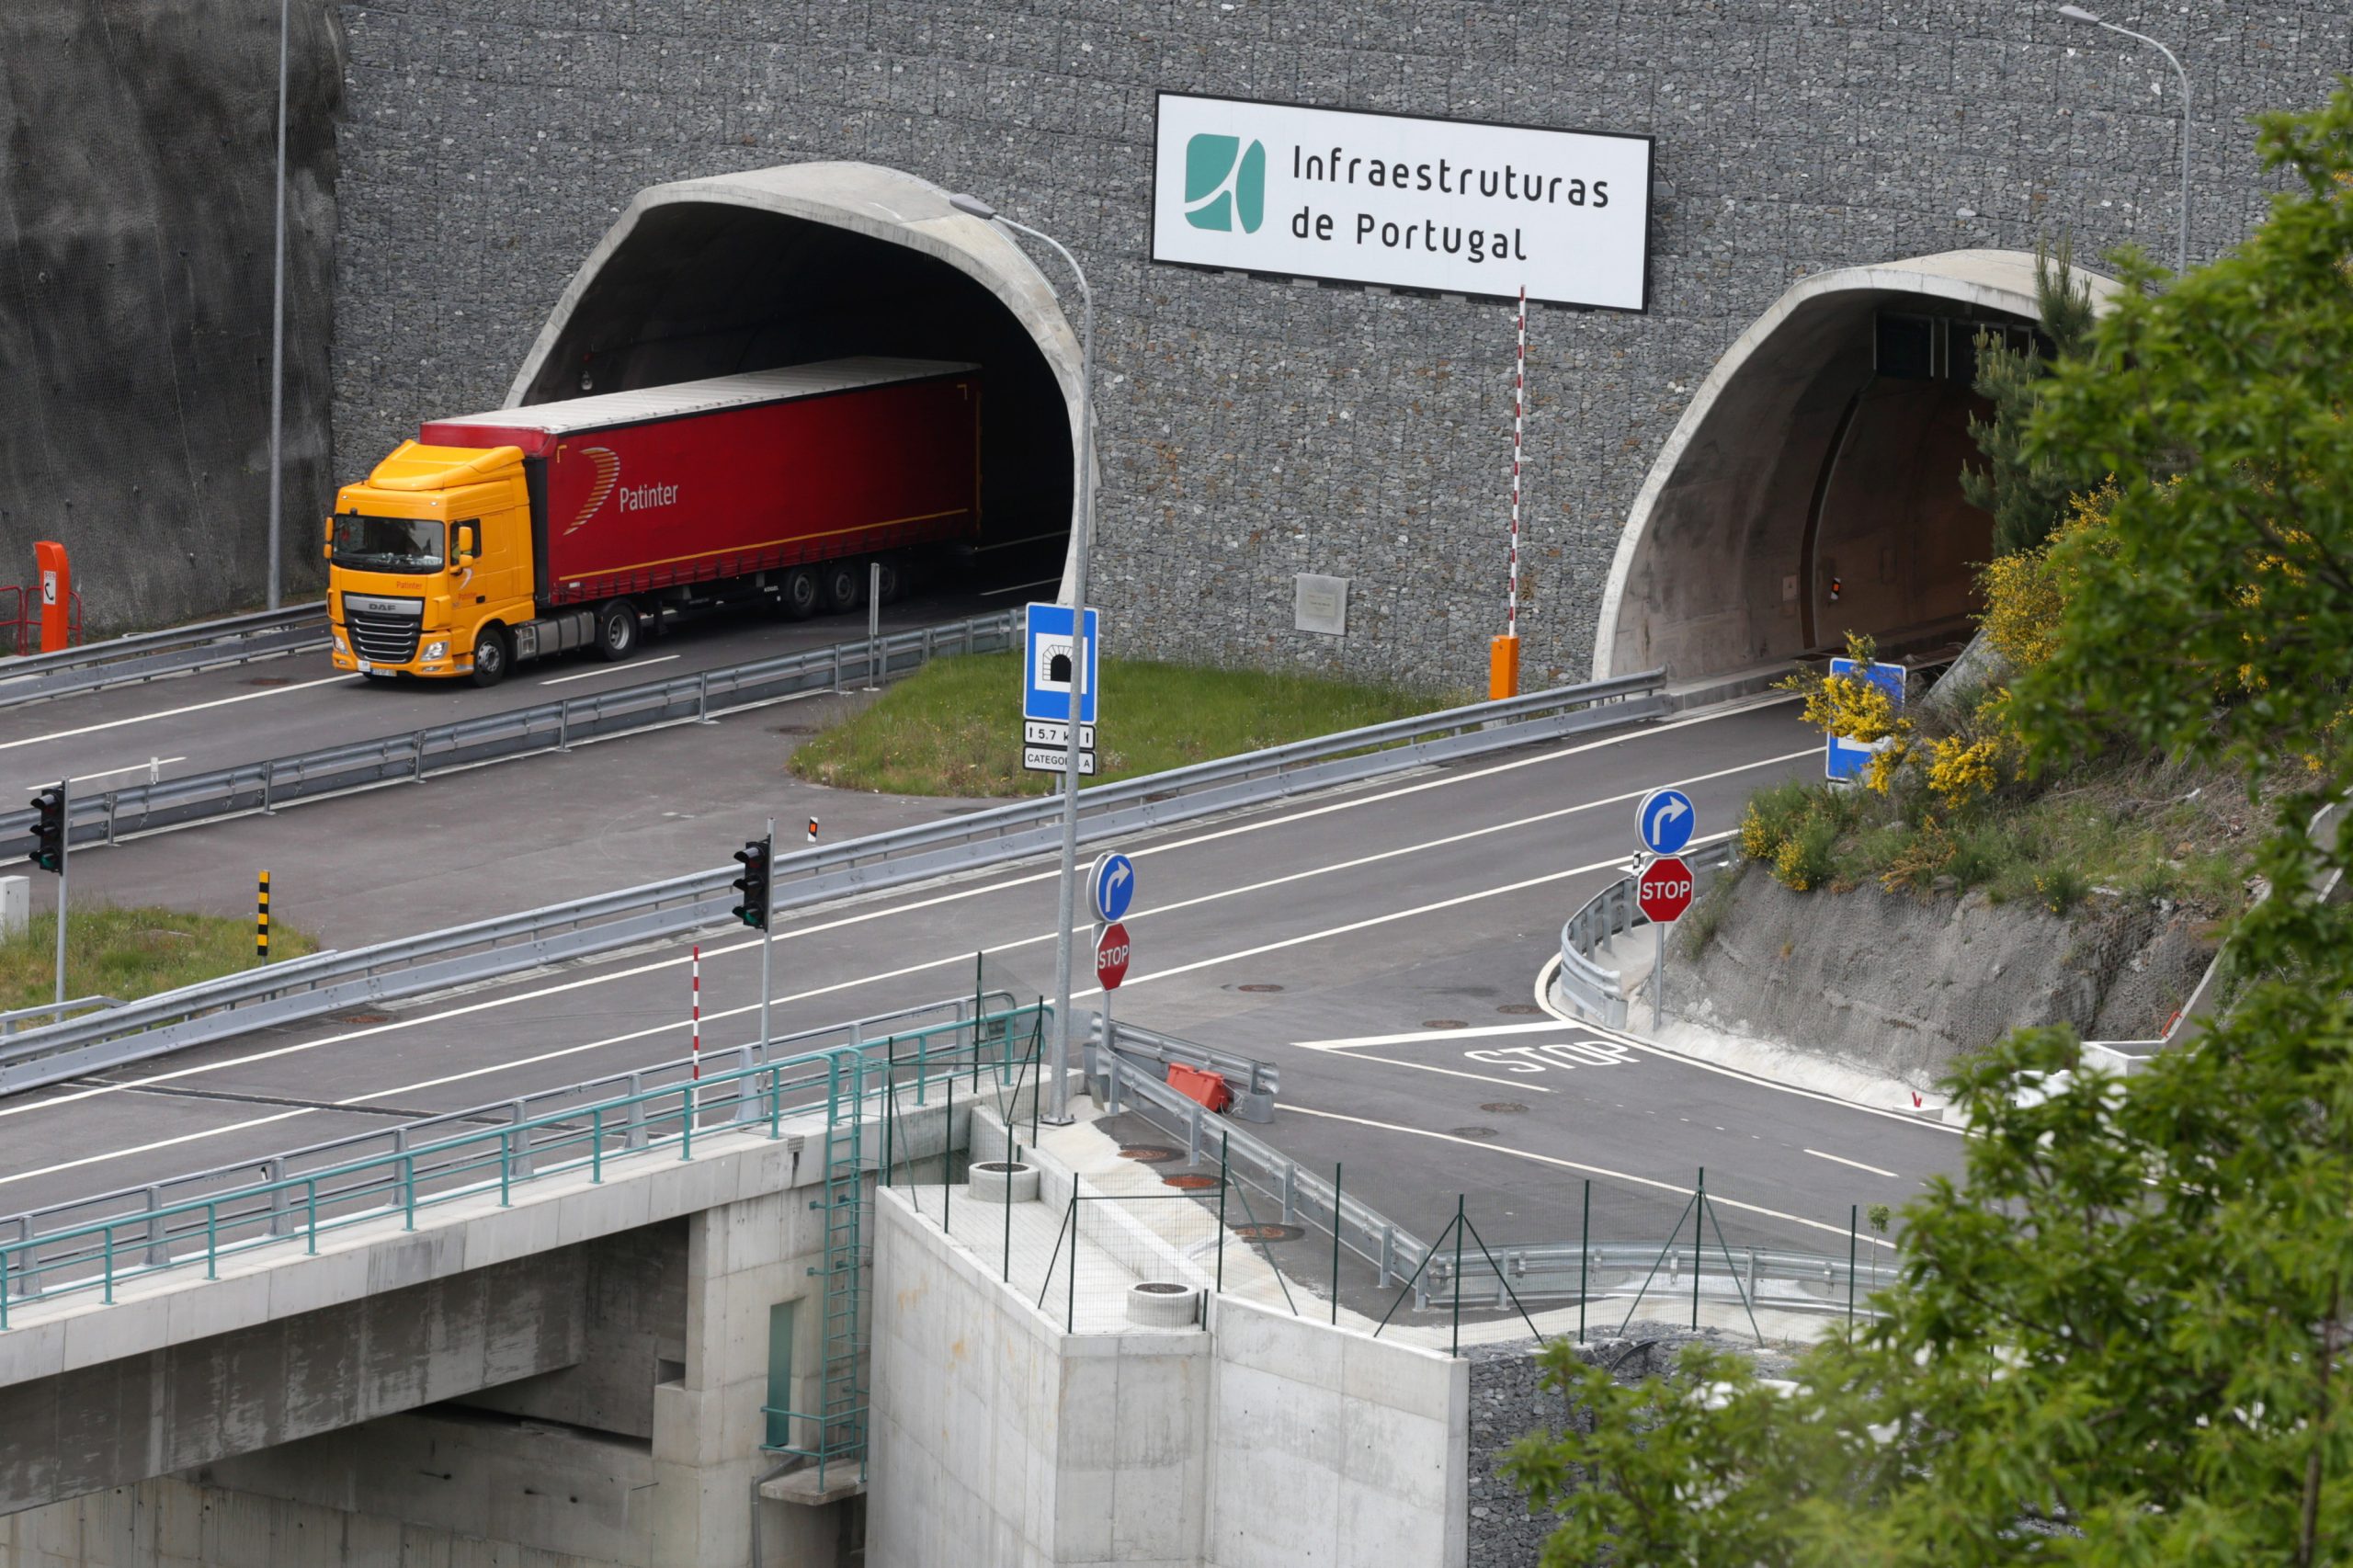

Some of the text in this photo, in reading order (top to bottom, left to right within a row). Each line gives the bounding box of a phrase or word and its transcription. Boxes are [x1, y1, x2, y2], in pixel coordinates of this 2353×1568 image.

[1292, 144, 1609, 209] Infraestruturas
[1291, 206, 1528, 263] de Portugal
[620, 482, 678, 513] Patinter
[369, 603, 397, 612] DAF
[1038, 728, 1056, 741] 5.7
[1084, 758, 1091, 768] A
[1642, 881, 1690, 900] STOP
[1098, 944, 1129, 970] STOP
[1464, 1040, 1641, 1073] STOP
